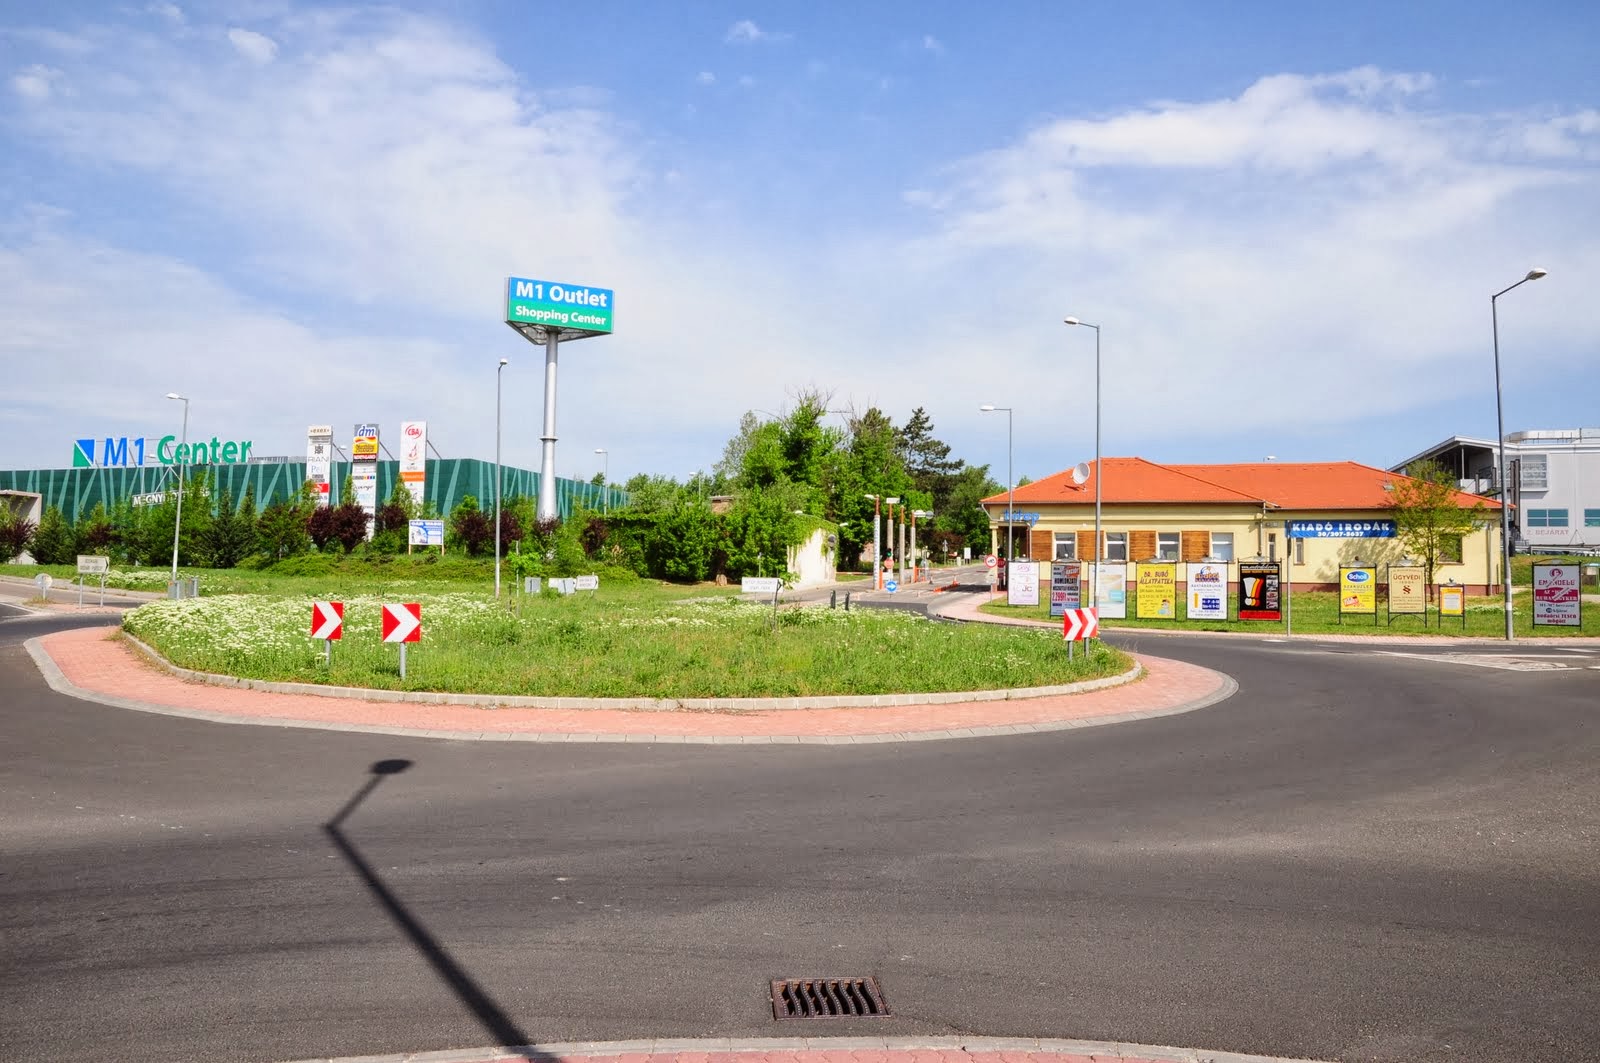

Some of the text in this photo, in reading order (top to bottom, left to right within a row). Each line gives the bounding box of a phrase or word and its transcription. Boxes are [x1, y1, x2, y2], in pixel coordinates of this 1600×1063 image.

[516, 281, 607, 307] M1 Outlet
[515, 305, 607, 325] Shopping Center
[358, 424, 375, 438] dm
[407, 428, 420, 436] CBA
[103, 434, 252, 467] M1 Center
[1292, 521, 1390, 531] KIADÓ IRODÁK
[1139, 576, 1174, 585] ÁLLATPATIKA
